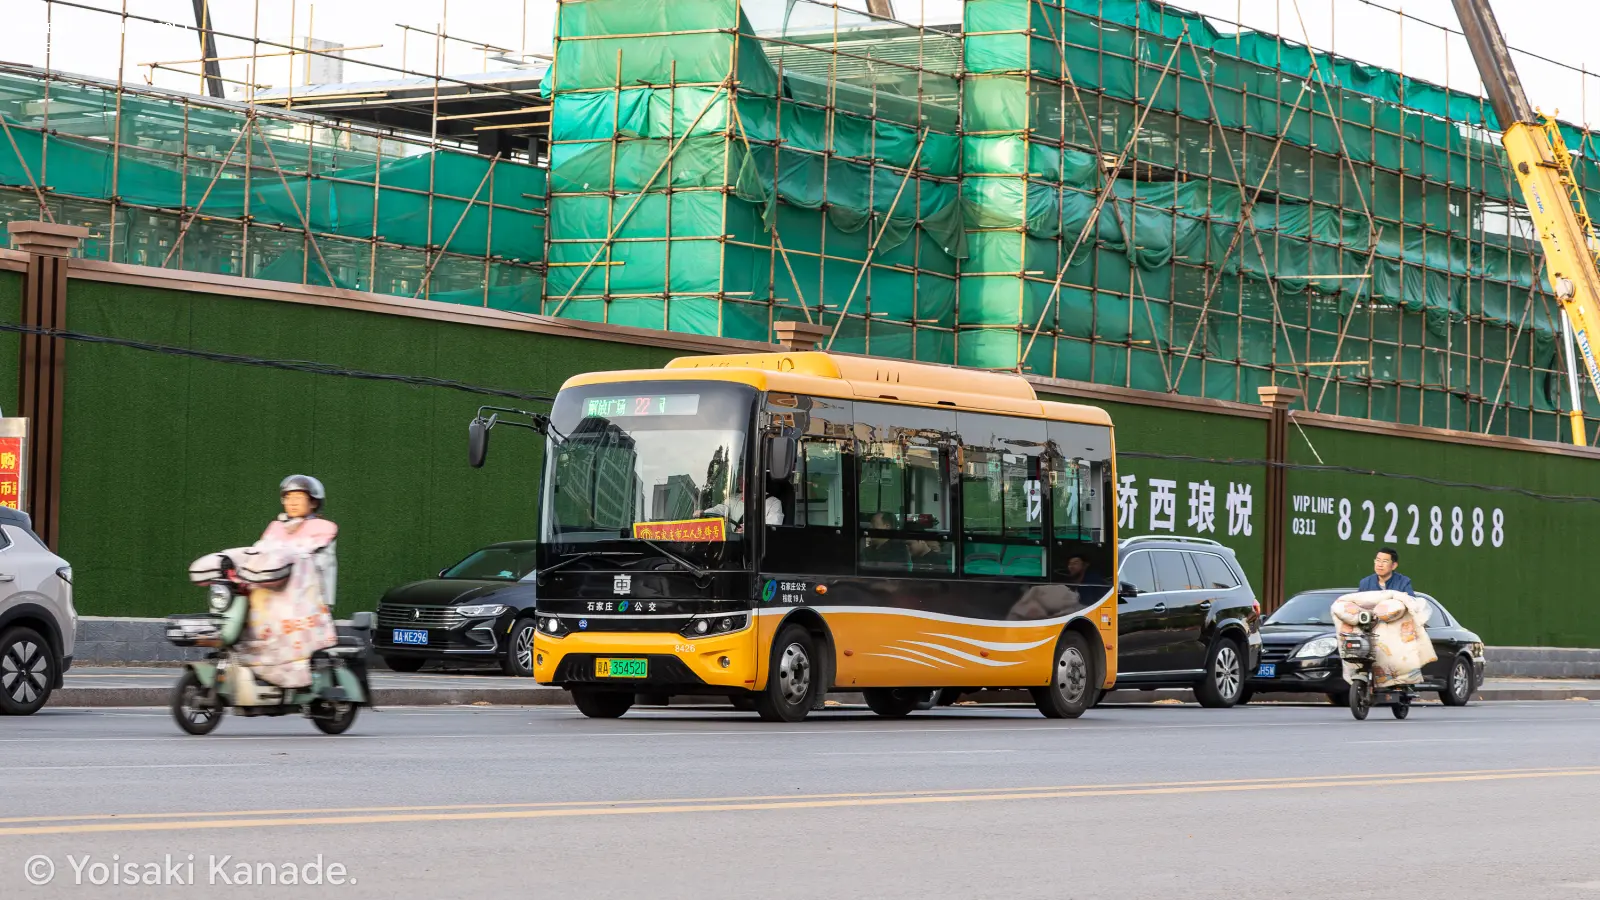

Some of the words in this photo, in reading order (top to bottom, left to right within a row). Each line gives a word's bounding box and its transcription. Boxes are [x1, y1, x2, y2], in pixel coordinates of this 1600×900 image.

[634, 397, 651, 415] 22
[0, 452, 16, 470] 购
[1293, 495, 1310, 513] VIP
[1311, 497, 1335, 515] LINE
[1292, 517, 1316, 536] 0311
[1337, 498, 1505, 548] 82228888
[780, 581, 807, 591] 石家庄公交
[587, 601, 613, 612] 石家庄
[634, 601, 656, 612] 公交
[675, 644, 696, 653] 8426
